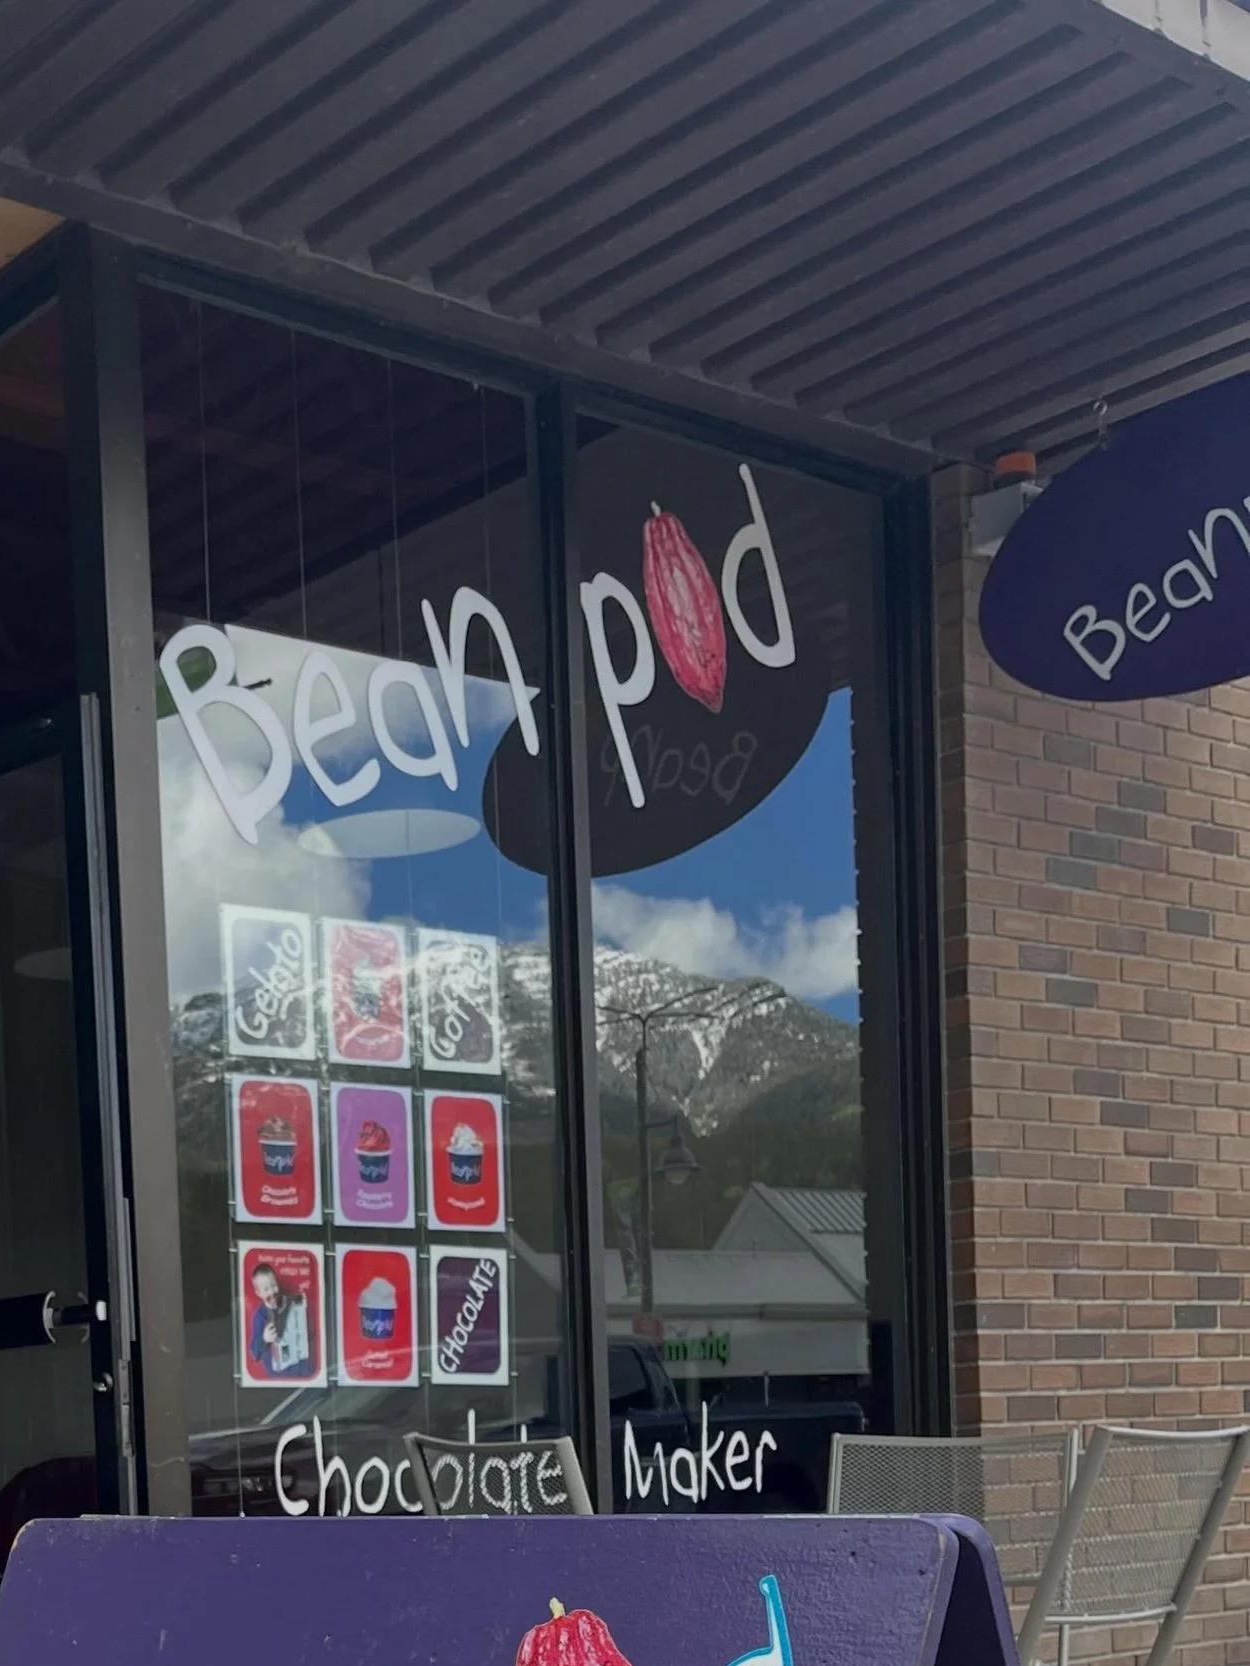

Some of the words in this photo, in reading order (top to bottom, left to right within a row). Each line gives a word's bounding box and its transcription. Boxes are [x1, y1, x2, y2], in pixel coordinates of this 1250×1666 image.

[1064, 497, 1250, 680] Bean
[235, 928, 303, 1040] Gelato
[438, 1258, 496, 1375] CHOCOLATE
[274, 1408, 566, 1517] Chocolate
[623, 1401, 778, 1506] Maker
